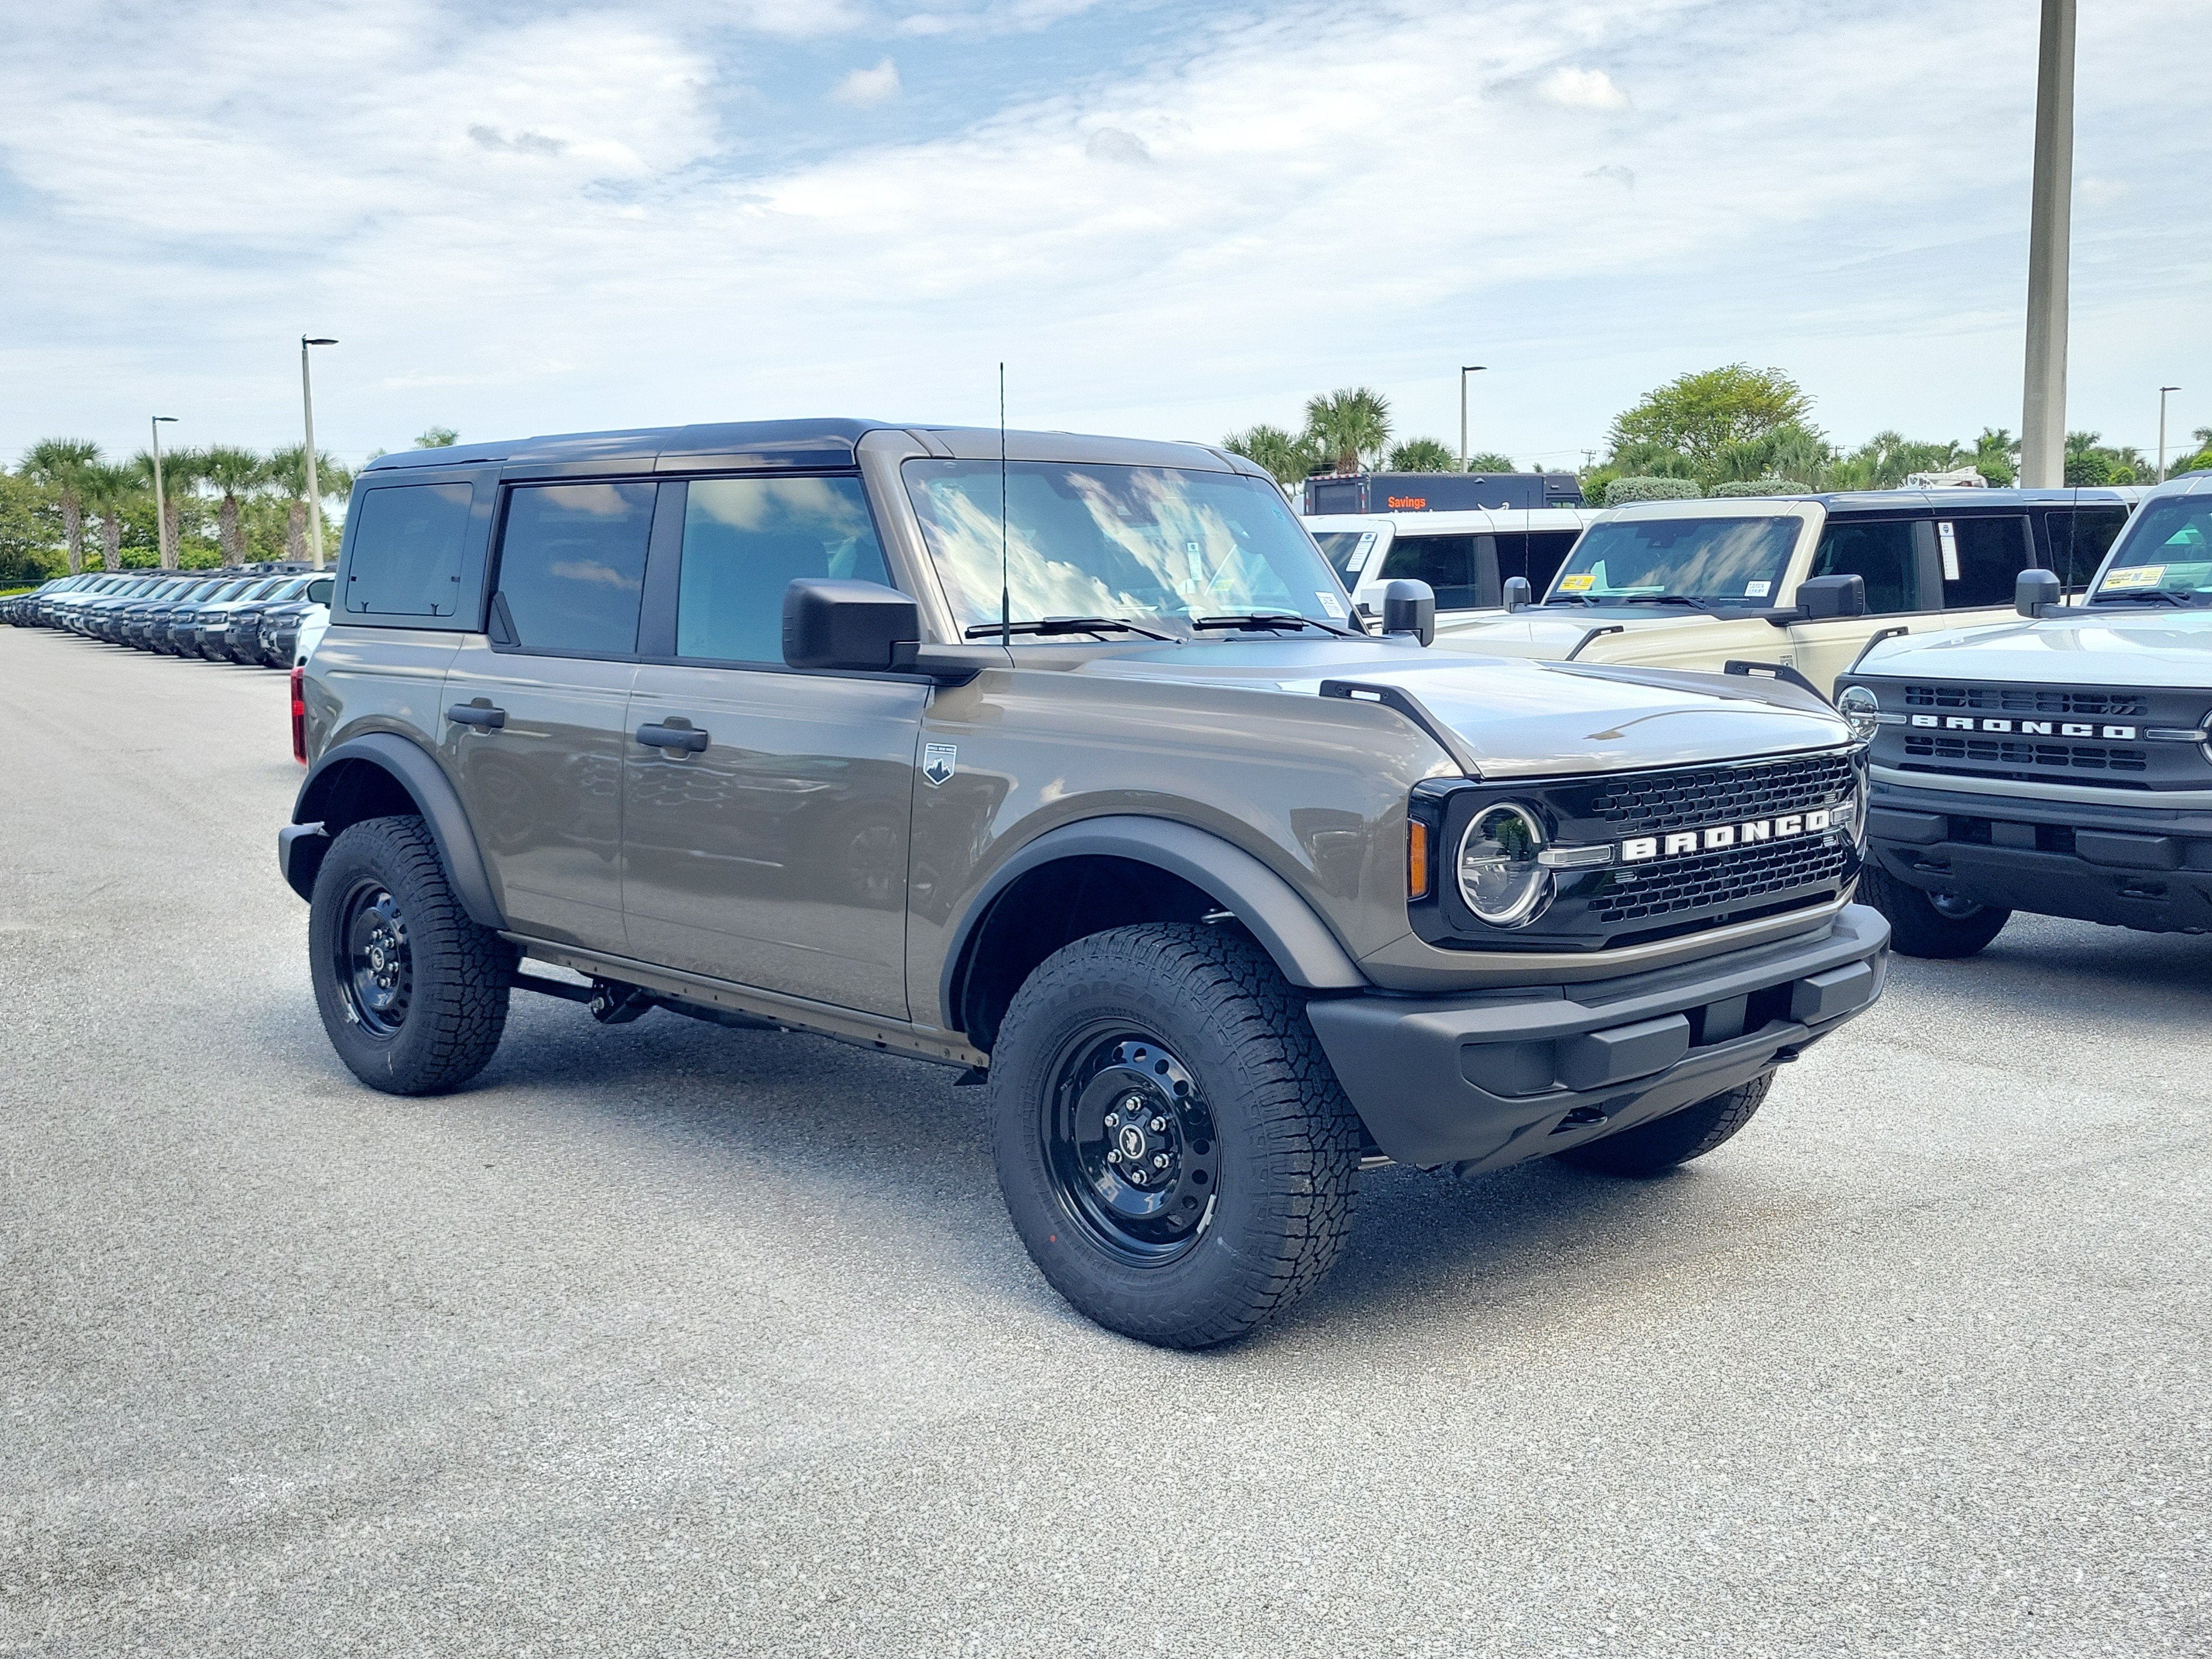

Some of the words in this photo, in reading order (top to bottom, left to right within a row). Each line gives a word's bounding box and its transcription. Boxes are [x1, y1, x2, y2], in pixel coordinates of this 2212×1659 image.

[1388, 496, 1425, 509] Savings
[1912, 714, 2136, 739] BRONCO
[1622, 810, 1829, 861] BRONCO
